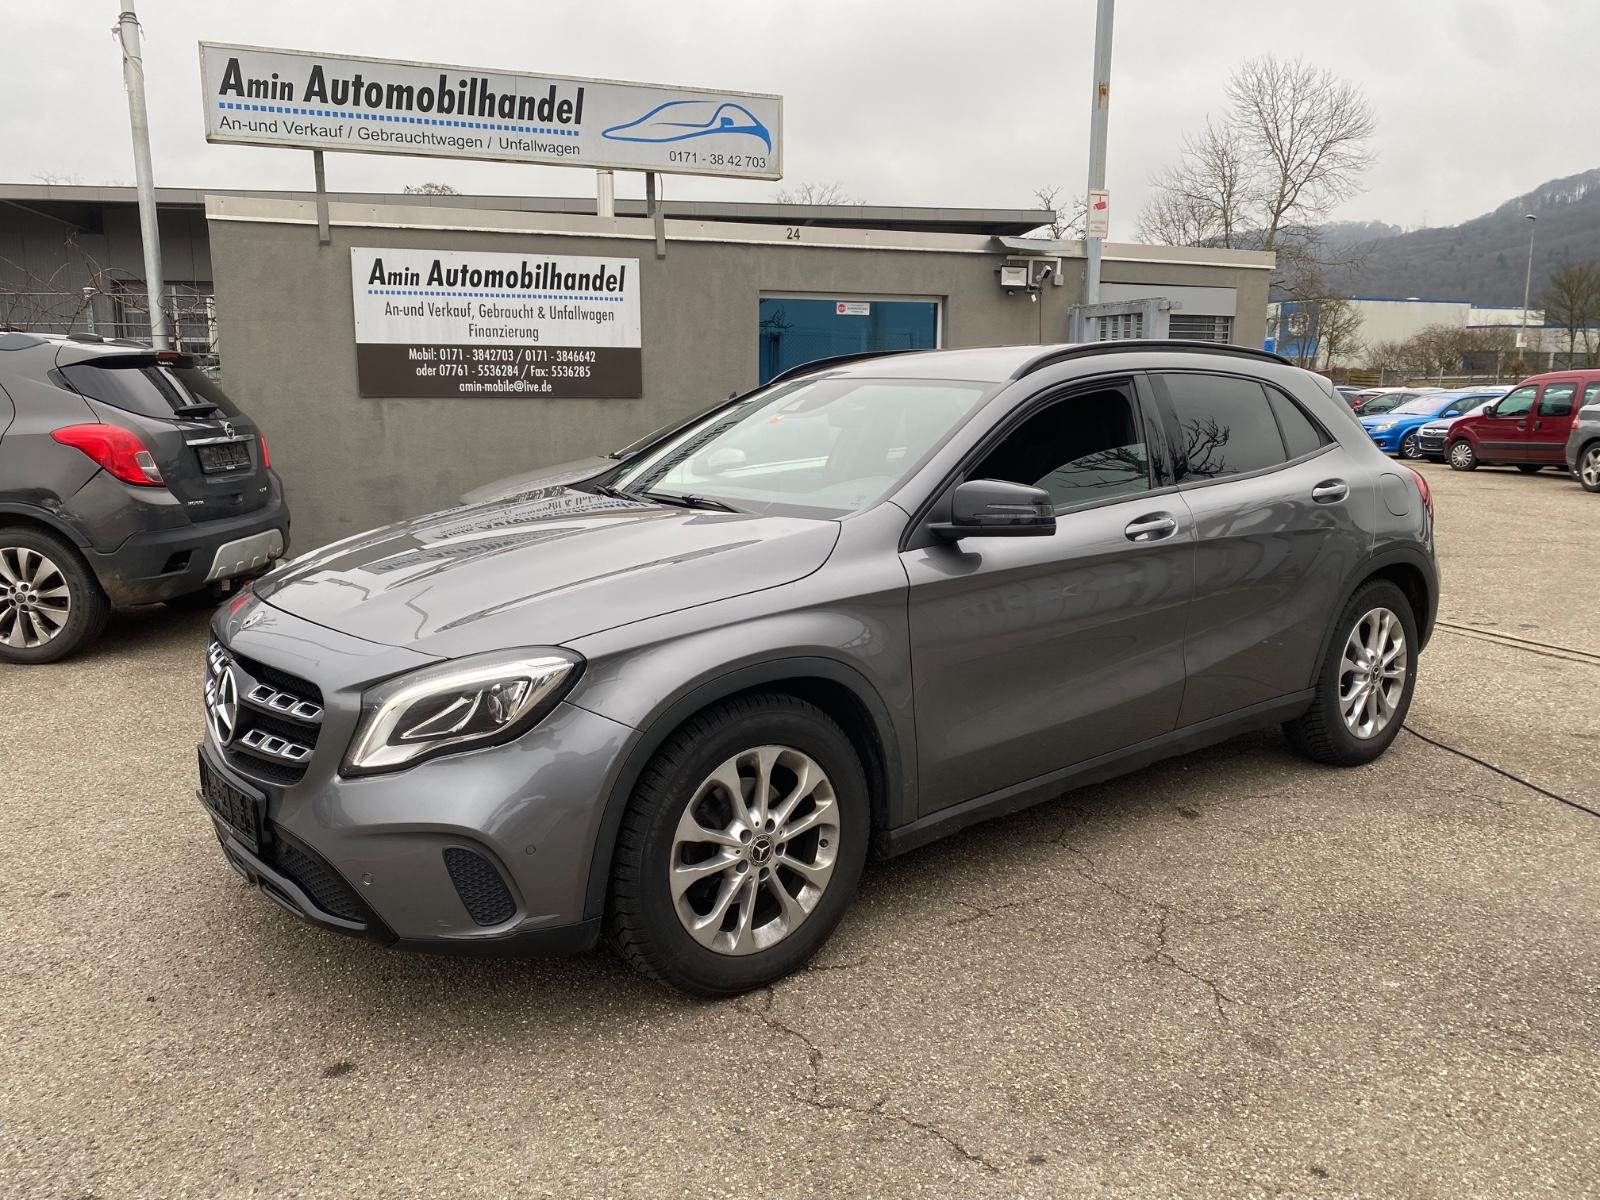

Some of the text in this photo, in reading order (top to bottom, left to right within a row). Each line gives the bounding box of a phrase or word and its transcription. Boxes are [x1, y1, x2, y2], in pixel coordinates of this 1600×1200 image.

[218, 57, 585, 125] Amin Automobilhandel
[219, 115, 580, 156] An-und Verkauf / Gebrauchtwagen / Unfallwagen
[669, 150, 698, 163] 0171
[709, 153, 724, 165] 38
[727, 155, 742, 167] 42
[744, 156, 766, 168] 703
[786, 227, 801, 240] 24
[367, 257, 626, 293] Amin Automobilhandel
[384, 301, 615, 325] An-und Verkauf, Gebraucht & Unfallwagen
[468, 323, 540, 342] Finanzierung
[408, 347, 437, 360] Mobil:
[439, 348, 463, 361] 0171
[472, 349, 514, 361] 3842703
[515, 348, 524, 364] /
[525, 349, 548, 362] 0171
[556, 350, 596, 363] 3846642
[415, 363, 437, 376] oder
[439, 364, 468, 377] 07761
[477, 364, 519, 377] 5536284
[520, 364, 529, 379] /
[530, 365, 549, 377] Fax:
[551, 365, 591, 378] 5536285
[459, 379, 553, 392] amin-mobile@live.de
